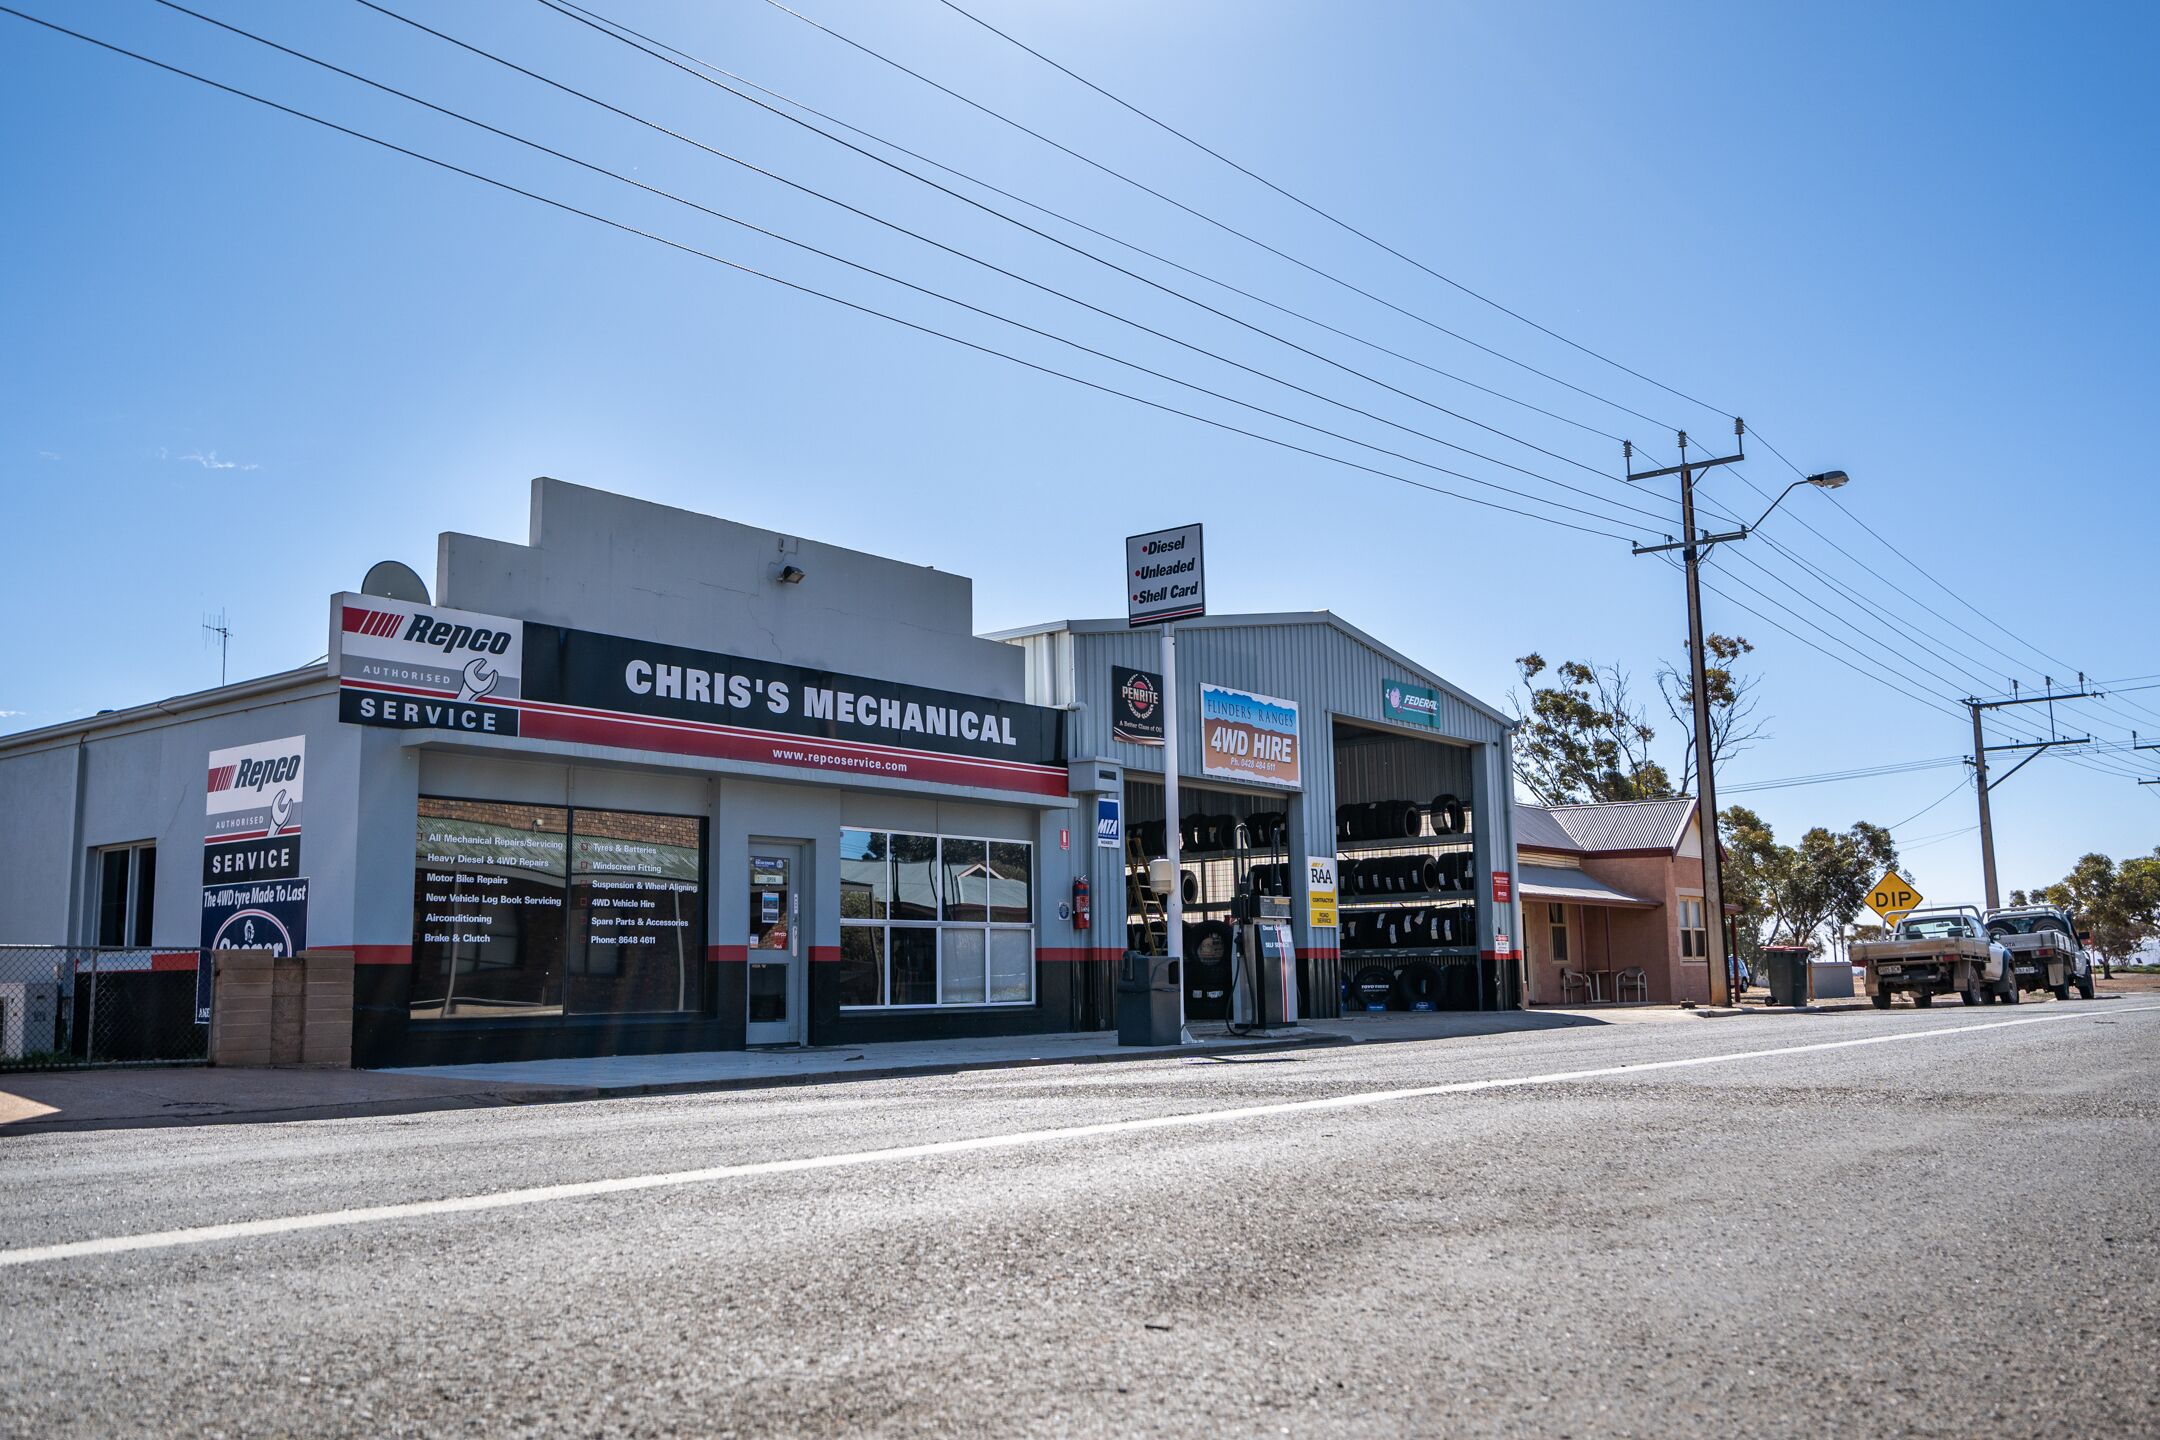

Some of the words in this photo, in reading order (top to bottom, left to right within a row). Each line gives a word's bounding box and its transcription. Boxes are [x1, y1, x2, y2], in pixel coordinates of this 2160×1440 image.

[1148, 536, 1185, 555] Diesel
[1140, 557, 1195, 580] Unleaded
[1138, 587, 1167, 604] Shell
[1170, 581, 1198, 598] Card
[403, 613, 512, 655] Repco
[363, 665, 450, 684] AUTHORISED
[625, 659, 790, 714] CHRIS'S
[804, 686, 1017, 746] MECHANICAL
[1122, 686, 1158, 705] PENRITE
[1404, 694, 1438, 710] FEDERAL
[360, 698, 496, 732] SERVICE
[1208, 699, 1252, 720] FLINDERS
[1258, 709, 1293, 727] RANGES
[1211, 726, 1249, 756] 4WD
[1253, 733, 1292, 763] HIRE
[772, 749, 908, 773] www.repcoservice.com
[234, 754, 301, 792] Repco
[215, 815, 264, 829] AUTHORISED
[1098, 818, 1118, 835] MTA
[429, 833, 441, 842] All
[444, 834, 492, 845] Mechanical
[494, 837, 564, 850] Repairs/Servicing
[593, 843, 613, 853] Tyres
[615, 844, 622, 852] &
[624, 845, 657, 854] Batteries
[212, 848, 290, 874] SERVICE
[427, 853, 455, 864] Heavy
[457, 854, 484, 864] Diesel
[486, 855, 494, 864] &
[496, 856, 517, 865] 4WD
[519, 858, 549, 868] Repairs
[592, 862, 636, 871] Windscreen
[637, 864, 662, 874] Fitting
[426, 873, 454, 882] Motor
[456, 874, 475, 883] Bike
[477, 875, 508, 885] Repairs
[1310, 868, 1333, 884] RAA
[592, 880, 635, 890] Suspension
[636, 881, 643, 890] &
[645, 882, 667, 891] Wheel
[668, 883, 698, 893] Aligning
[204, 890, 217, 908] The
[217, 889, 235, 907] 4WD
[235, 889, 251, 910] tyre
[250, 885, 274, 904] Made
[276, 885, 287, 902] To
[286, 884, 307, 901] Last
[426, 893, 447, 902] New
[449, 894, 480, 903] Vehicle
[482, 894, 498, 905] Log
[500, 895, 523, 905] Book
[524, 896, 562, 907] Servicing
[591, 898, 610, 907] 4WD
[612, 899, 639, 908] Vehicle
[640, 899, 656, 908] Hire
[1875, 891, 1912, 907] DIP
[425, 913, 493, 924] Airconditioning
[591, 916, 614, 926] Spare
[615, 917, 636, 926] Parts
[637, 917, 644, 926] &
[646, 918, 689, 927] Accessories
[424, 933, 450, 943] Brake
[452, 933, 460, 943] &
[462, 934, 491, 943] Clutch
[590, 935, 617, 944] Phone:
[618, 936, 638, 944] 8648
[640, 936, 656, 944] 4611
